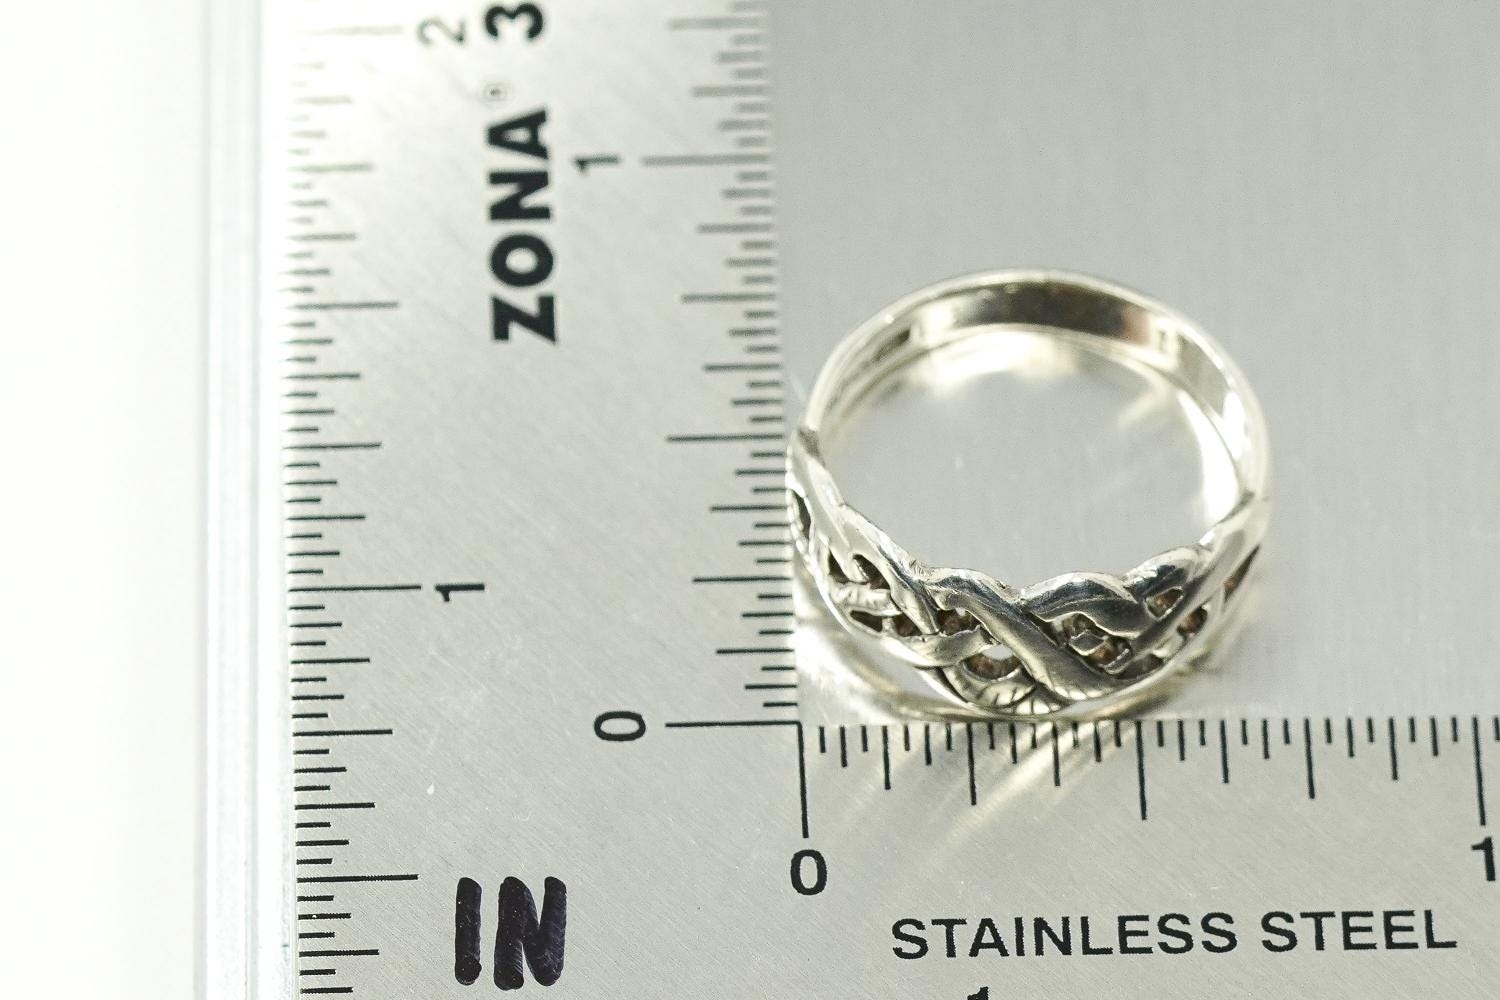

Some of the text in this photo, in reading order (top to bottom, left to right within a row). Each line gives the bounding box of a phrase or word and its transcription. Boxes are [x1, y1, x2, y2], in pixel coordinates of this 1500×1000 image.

[417, 16, 466, 46] 2
[484, 2, 557, 345] ZONA 3
[574, 154, 621, 174] 1
[435, 583, 486, 602] 1
[594, 711, 647, 741] 0
[790, 849, 829, 896] 0
[1471, 836, 1497, 882] 1
[455, 876, 568, 991] IN
[892, 909, 1459, 961] STAINLESS STEEL
